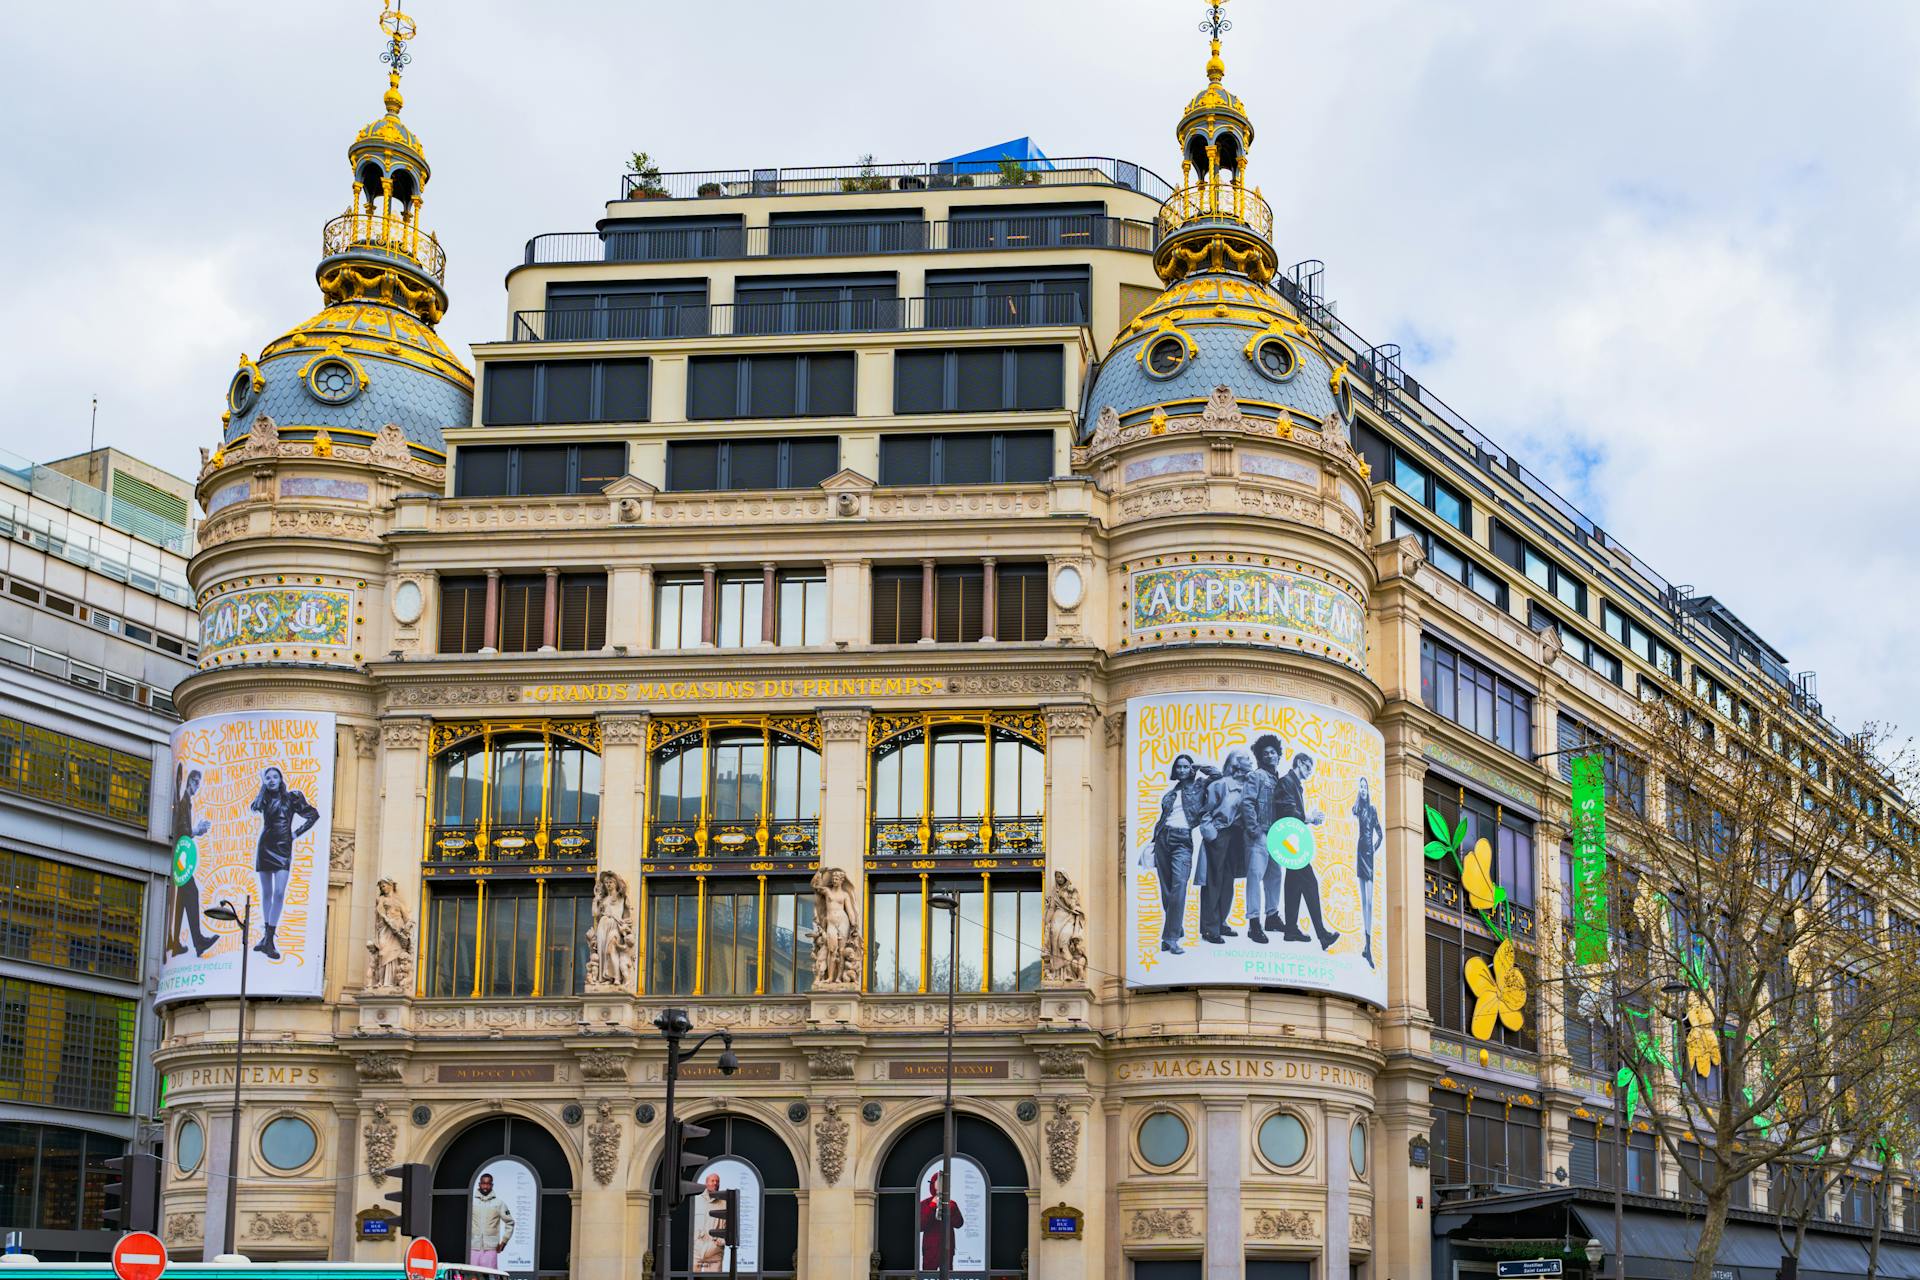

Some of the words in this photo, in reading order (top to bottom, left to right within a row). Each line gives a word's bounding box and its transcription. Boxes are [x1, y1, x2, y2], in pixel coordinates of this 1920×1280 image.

[1149, 580, 1196, 616] AU
[534, 683, 628, 701] GRANDS
[637, 680, 754, 699] MAGASINS
[764, 679, 794, 697] DU
[802, 677, 934, 696] PRINTEMPS
[1139, 703, 1234, 740] REJOIGNEZ
[1237, 704, 1250, 723] LE
[1252, 704, 1298, 738] CLUB
[217, 741, 249, 760] POUR
[284, 740, 314, 757] TOUT
[1139, 728, 1248, 772] PRINTEMPS
[288, 757, 321, 774] TEMPS
[1136, 871, 1161, 901] CLUB
[1183, 886, 1200, 948] ACCESSIBLE
[1244, 961, 1336, 981] PRINTEMPS
[171, 1072, 183, 1089] DU
[192, 1067, 320, 1086] PRINTEMPS
[1152, 1059, 1274, 1077] MAGASINS
[1286, 1062, 1311, 1080] DU
